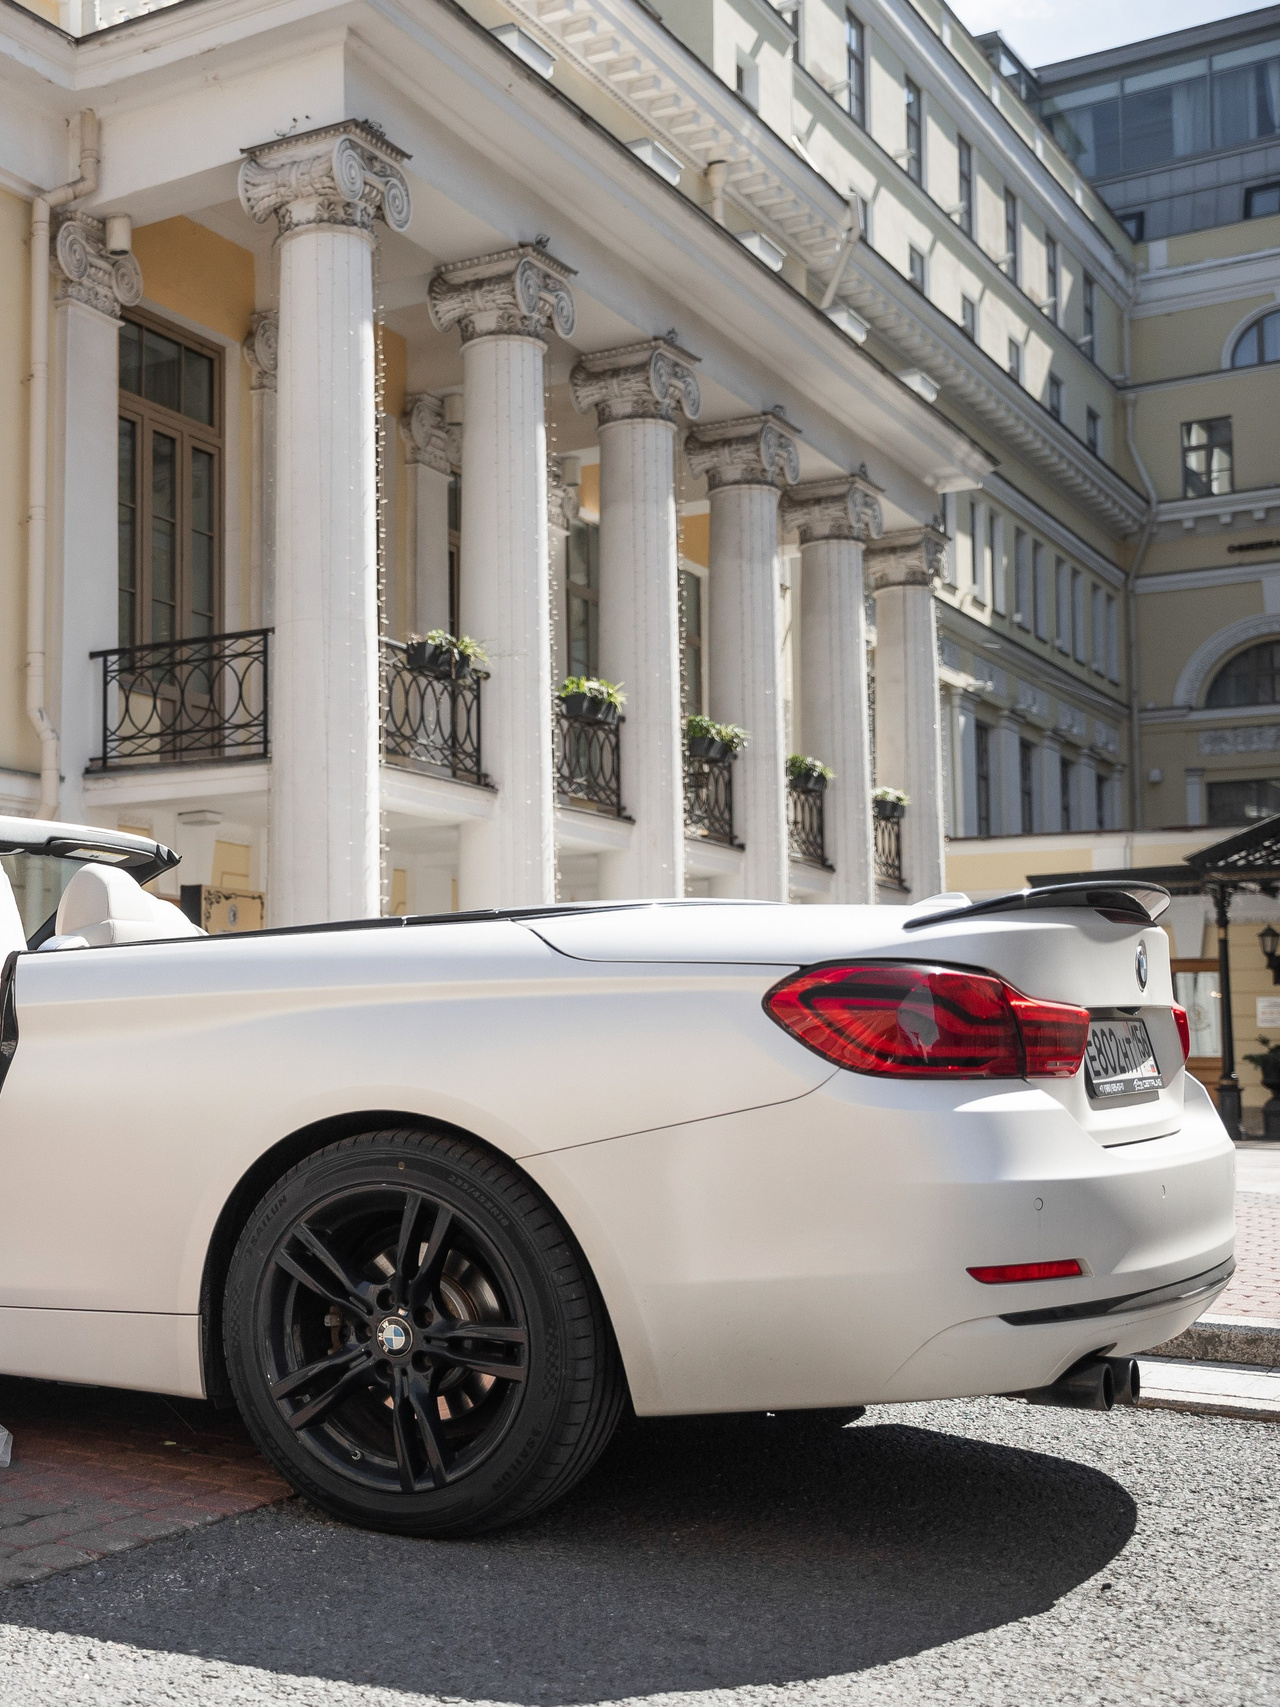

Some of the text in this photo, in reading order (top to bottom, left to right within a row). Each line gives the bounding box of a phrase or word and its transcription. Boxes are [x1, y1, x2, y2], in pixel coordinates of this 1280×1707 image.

[250, 1194, 288, 1248] SAILUN
[378, 1320, 389, 1353] BMW
[492, 1436, 536, 1492] SAILUN
